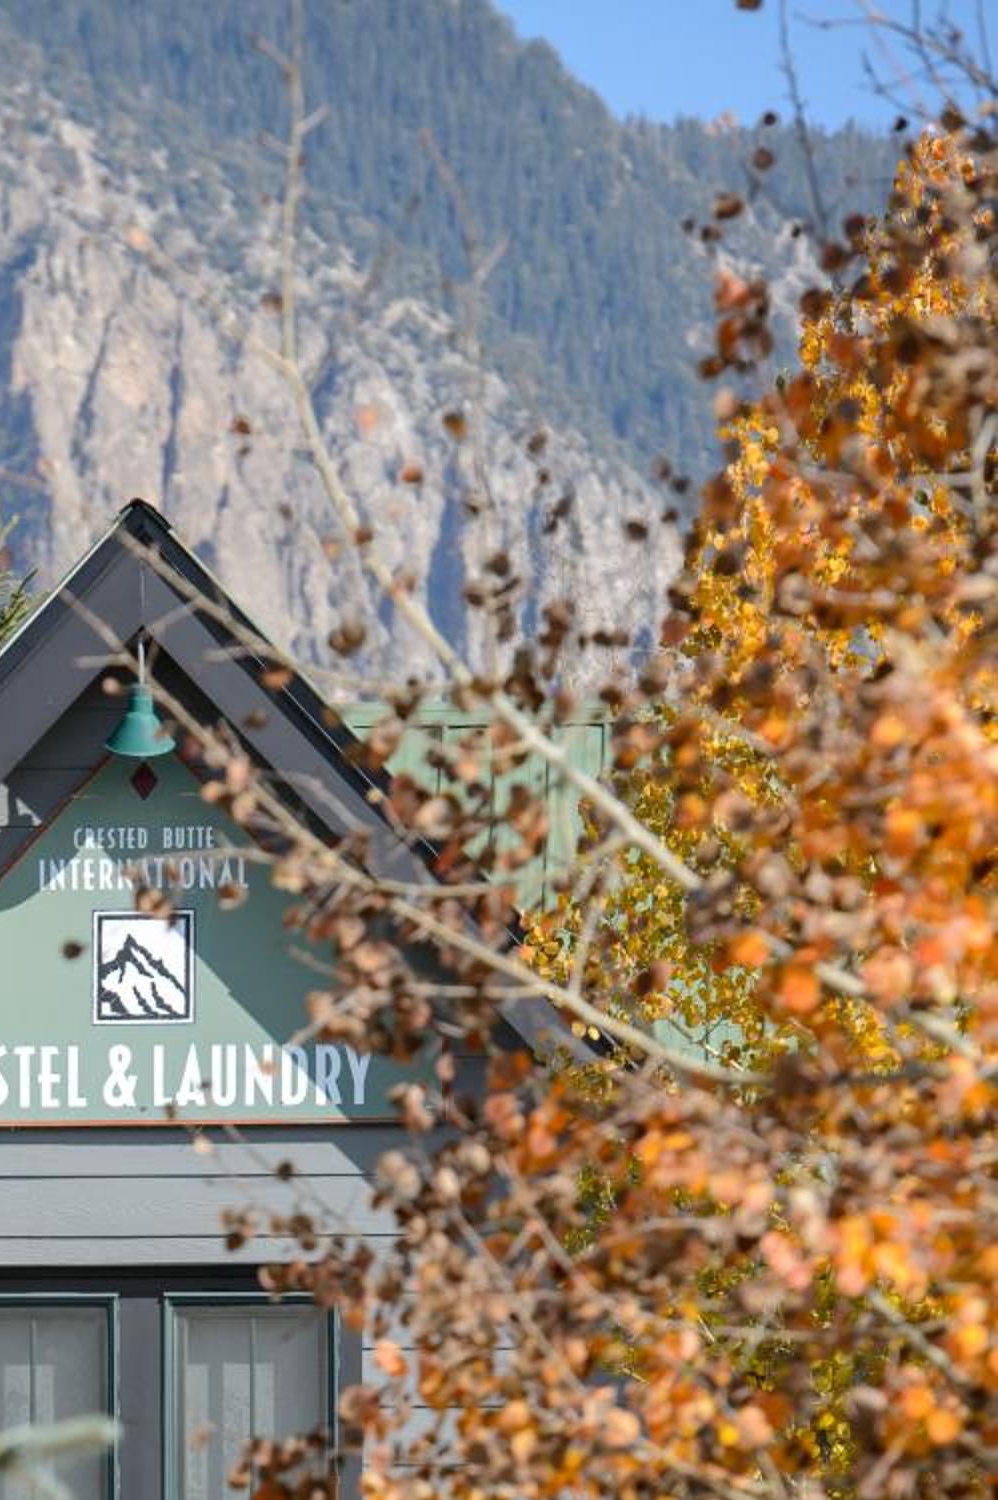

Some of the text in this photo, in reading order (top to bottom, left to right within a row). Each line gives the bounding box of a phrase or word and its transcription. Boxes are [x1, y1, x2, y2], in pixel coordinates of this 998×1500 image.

[73, 827, 215, 849] CRESTED BUTTE
[103, 1043, 138, 1108] &
[153, 1042, 373, 1107] LAUNDRY
